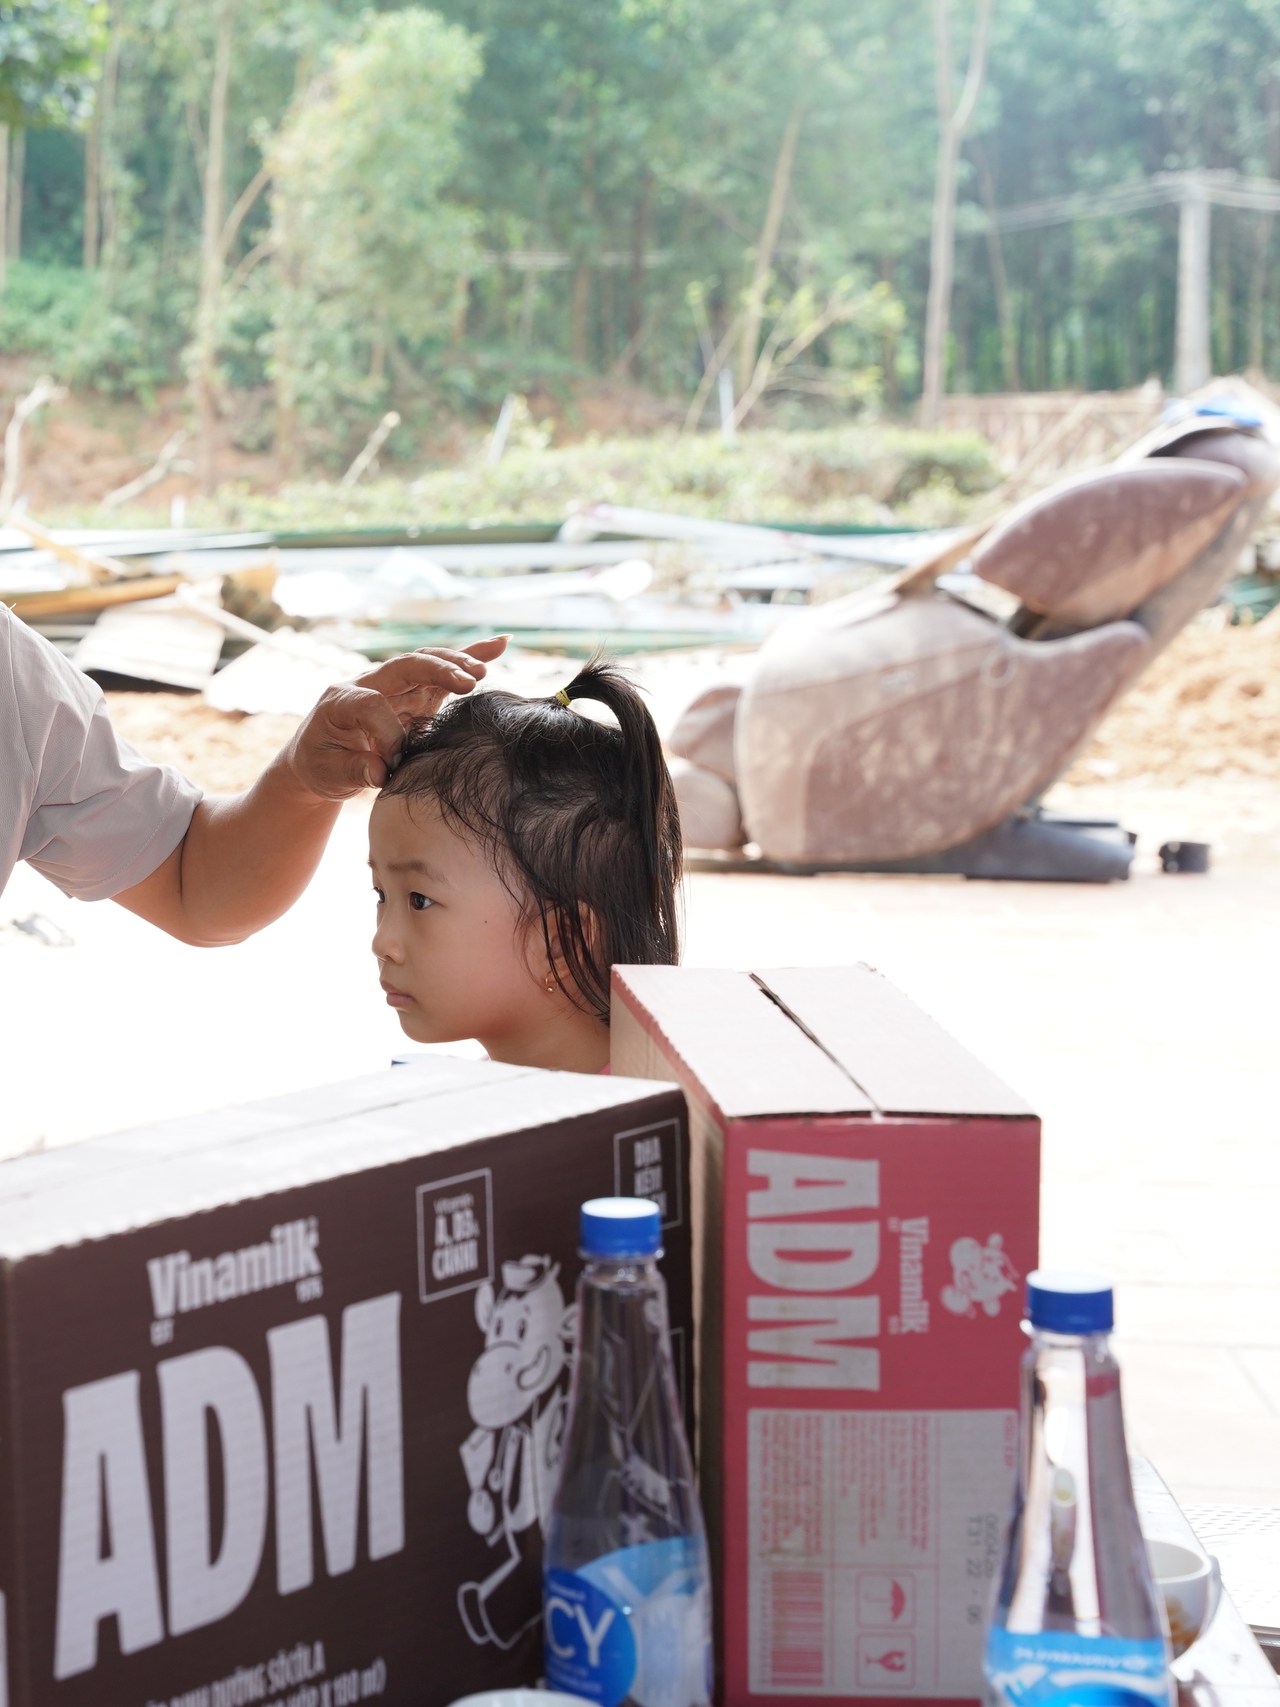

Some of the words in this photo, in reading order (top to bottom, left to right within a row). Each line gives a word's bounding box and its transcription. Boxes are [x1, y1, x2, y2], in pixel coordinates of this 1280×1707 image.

[146, 1217, 323, 1319] Vinamilk
[746, 1148, 880, 1391] ADM
[900, 1216, 930, 1333] Vinamilk
[54, 1291, 405, 1681] ADM
[546, 1596, 615, 1667] CY
